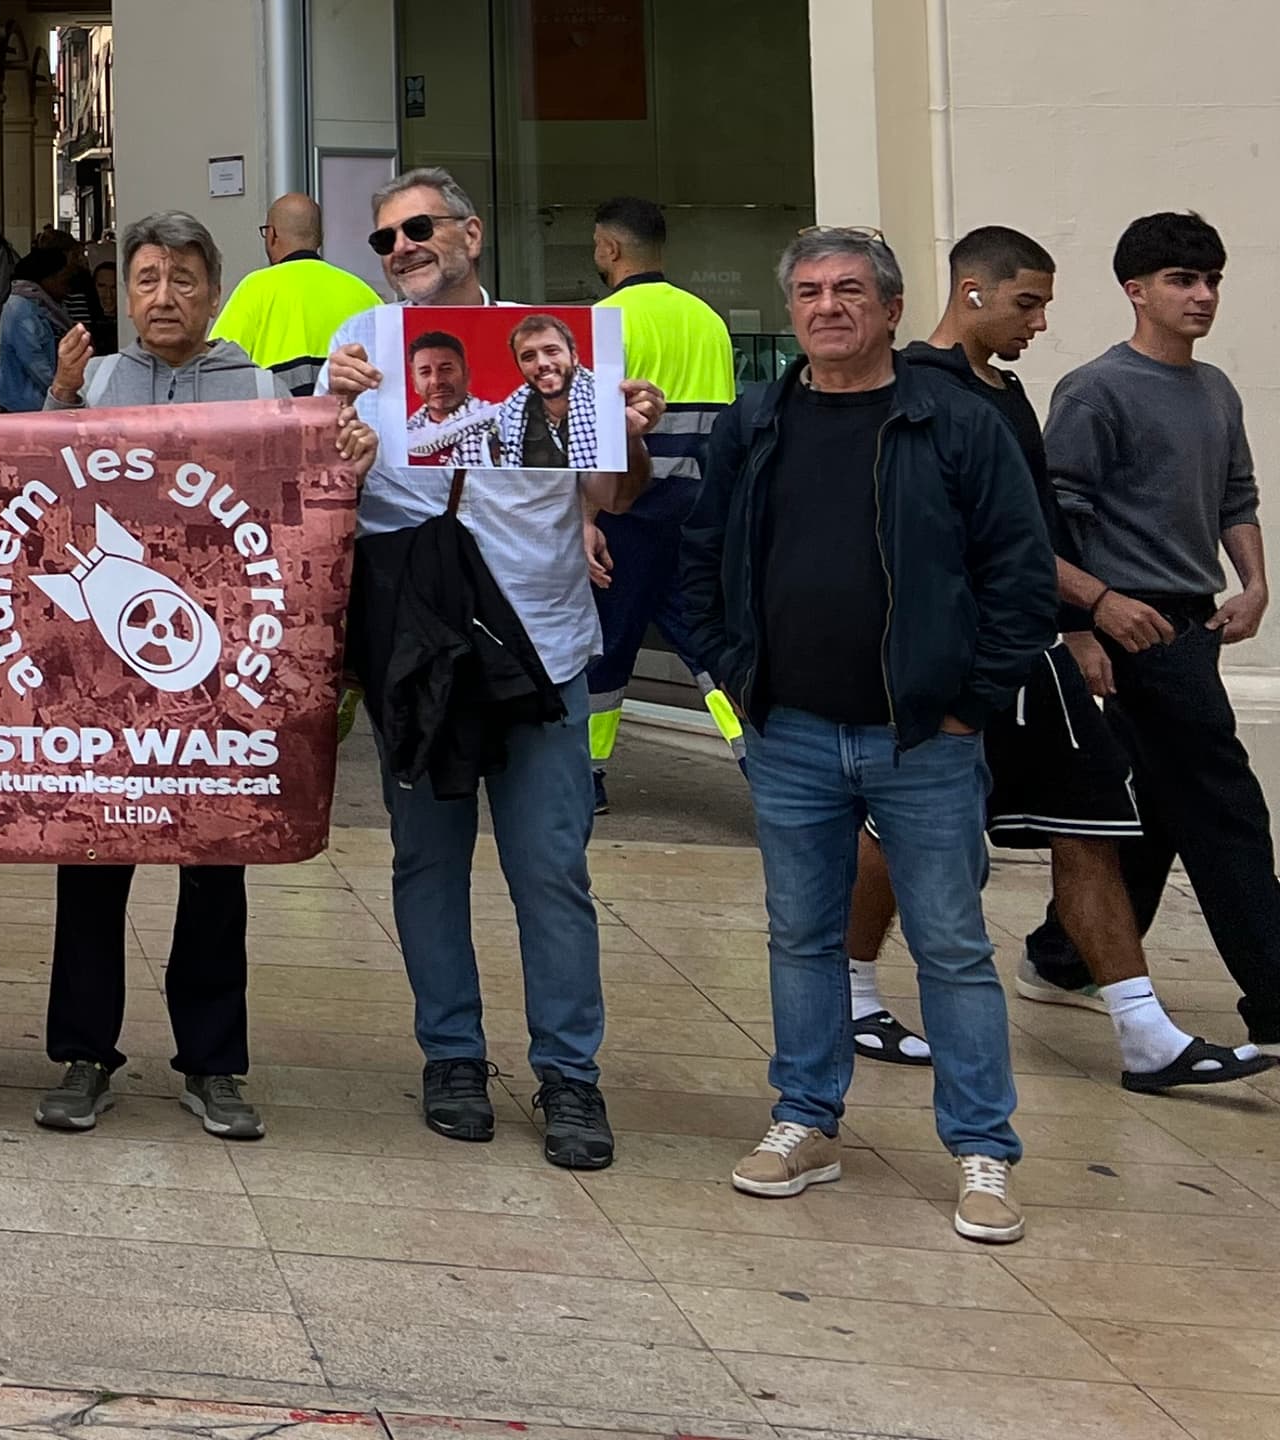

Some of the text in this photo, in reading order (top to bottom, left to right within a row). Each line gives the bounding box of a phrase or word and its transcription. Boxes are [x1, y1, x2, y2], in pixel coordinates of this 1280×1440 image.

[59, 445, 157, 490] les
[168, 462, 287, 710] guerres!
[122, 727, 280, 767] WARS
[103, 805, 173, 825] LLEIDA
